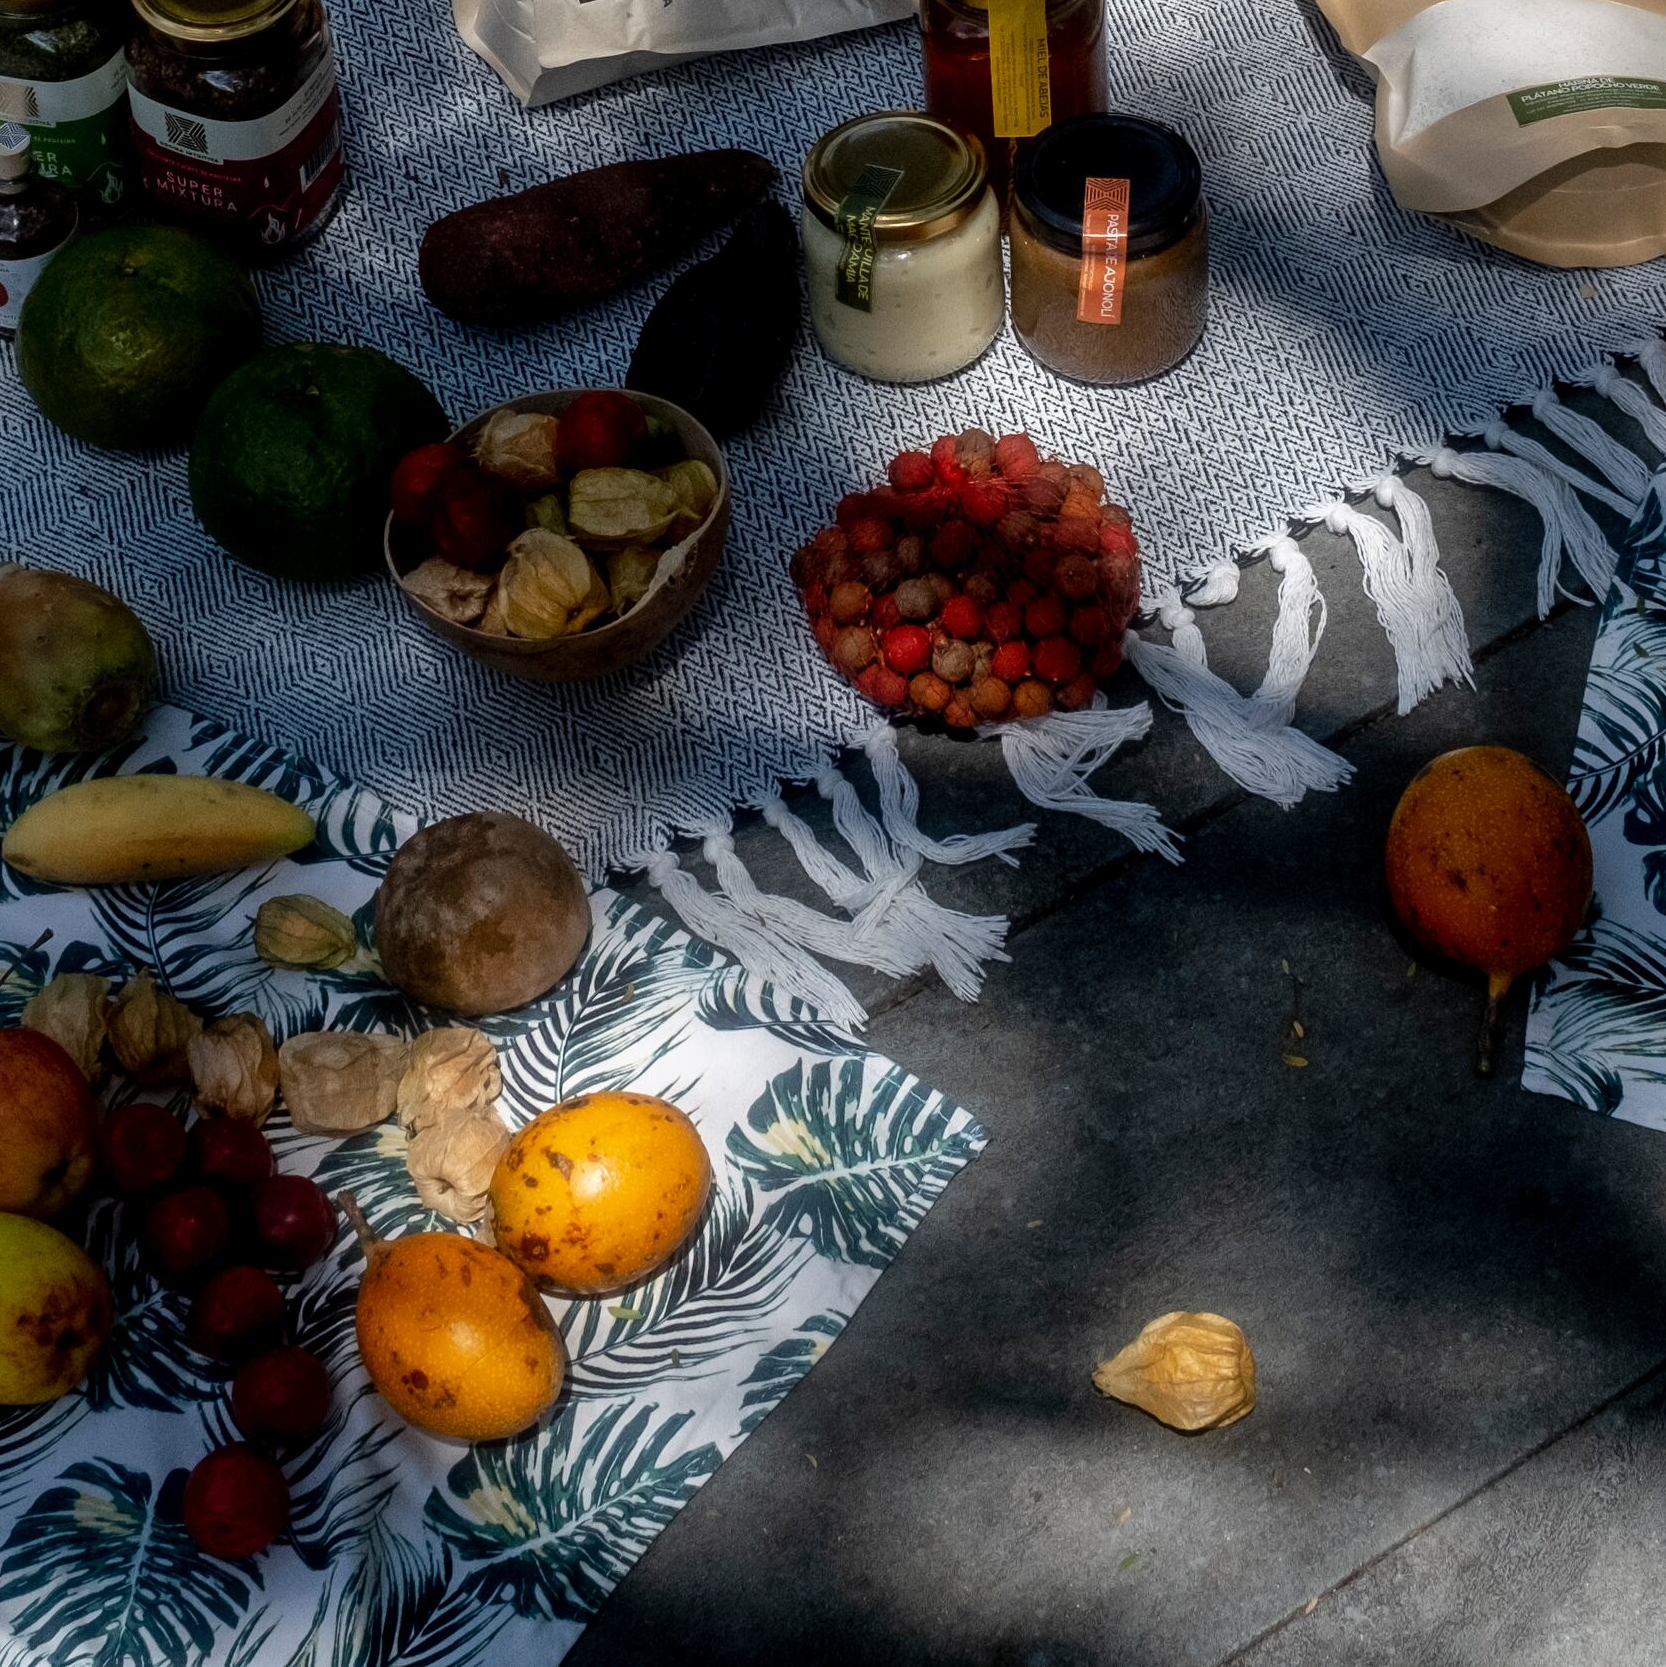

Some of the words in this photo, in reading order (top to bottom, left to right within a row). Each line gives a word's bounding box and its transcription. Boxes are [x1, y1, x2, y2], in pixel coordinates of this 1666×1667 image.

[1037, 37, 1045, 64] MIEL
[1038, 66, 1047, 81] DE
[1558, 77, 1598, 89] HARINA
[1599, 76, 1614, 84] DE
[1039, 83, 1049, 118] ABEJAS
[1520, 87, 1570, 104] PLÁTANO
[1570, 82, 1625, 93] POPOCHO
[1625, 82, 1661, 92] VERDE
[156, 179, 238, 212] MIXTURA
[166, 171, 223, 198] SUPER
[858, 206, 877, 284] MANTEUILLA
[1106, 213, 1119, 251] PASTA
[845, 214, 863, 283] MACDAMIA
[858, 285, 869, 301] DE
